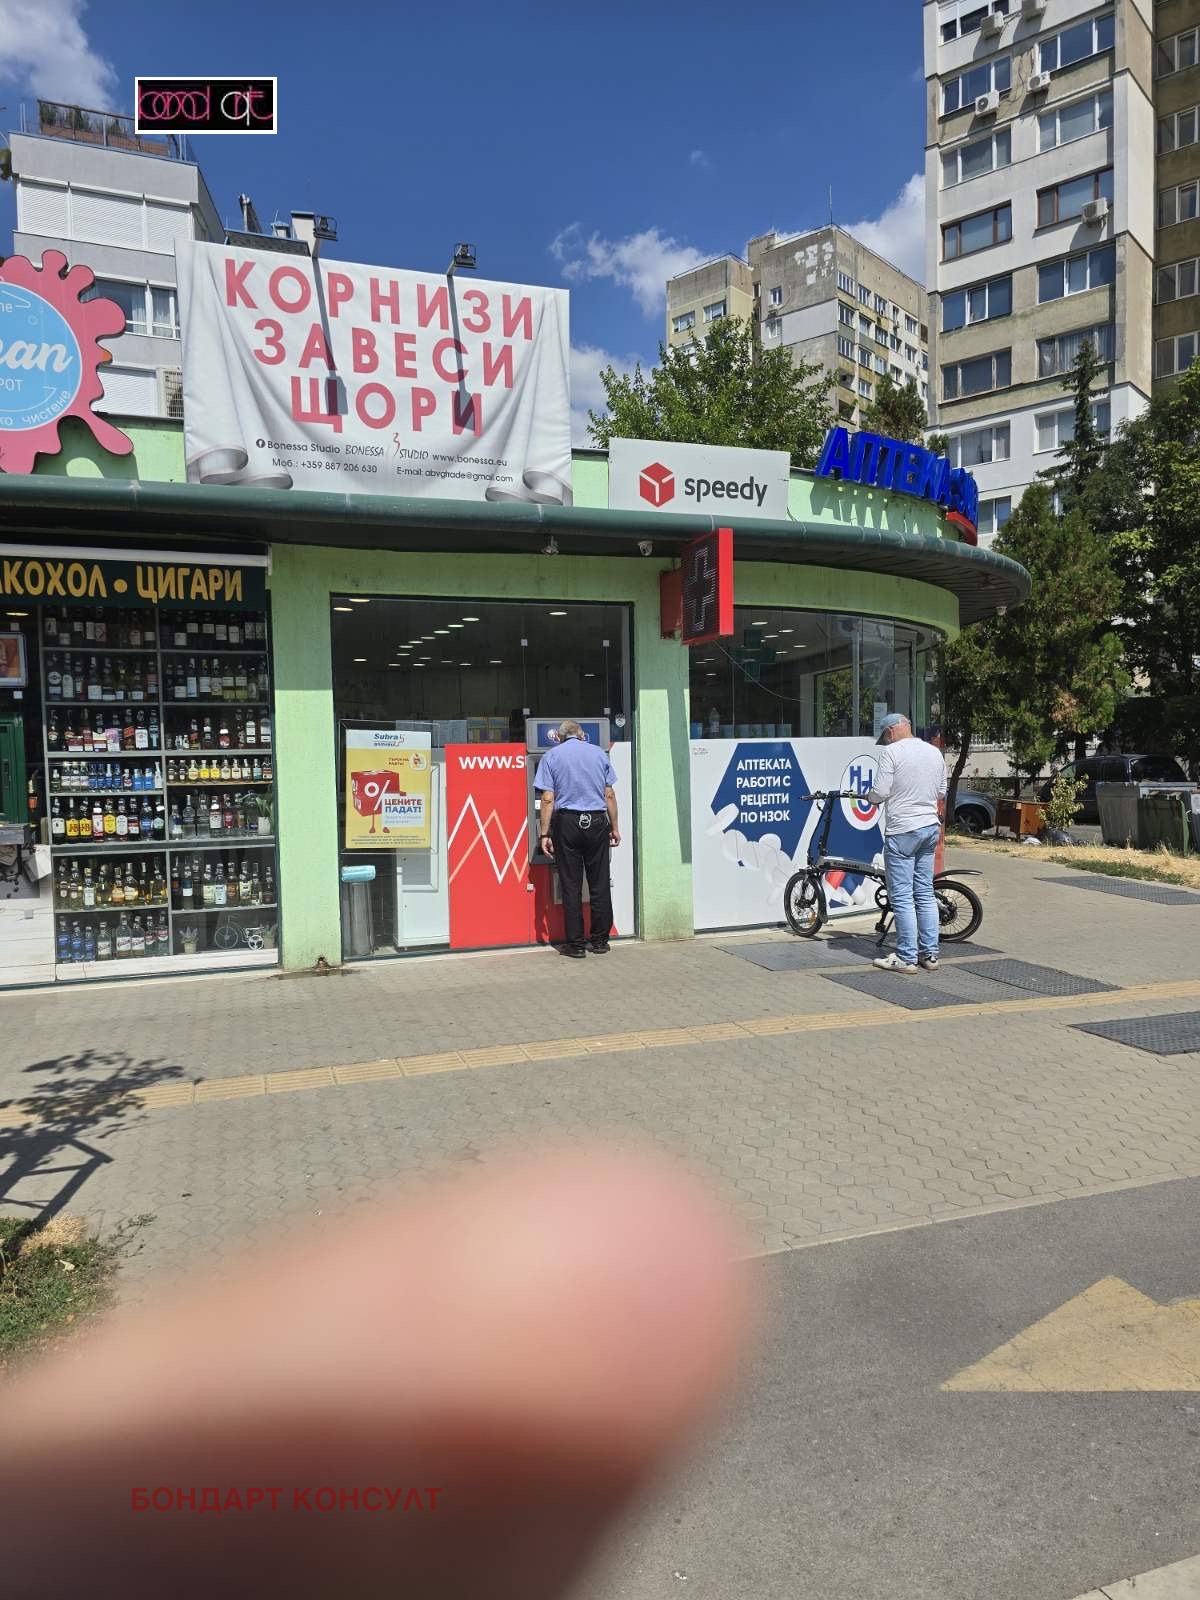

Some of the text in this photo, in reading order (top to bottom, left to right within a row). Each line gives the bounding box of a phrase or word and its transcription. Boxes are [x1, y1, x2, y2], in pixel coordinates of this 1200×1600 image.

[225, 259, 533, 340] КОРНИЗИ
[253, 318, 514, 389] ЗАВЕСИ
[290, 376, 484, 437] ЩОРИ
[267, 440, 508, 467] Bonessa Studio BONESSA STUDIO www.bonessa.eu
[301, 460, 323, 469] +359
[325, 462, 341, 470] 887
[343, 463, 359, 472] 206
[361, 464, 378, 473] 630
[816, 427, 950, 507] АПТЕКА
[684, 475, 768, 507] speedy
[0, 560, 243, 604] КОХОЛ ЦИГАРИ
[736, 758, 792, 771] АПТЕКАТА
[736, 775, 791, 788] РАБОТИ С
[384, 798, 422, 806] ЦЕНИТЕ
[385, 806, 422, 814] ПАДАТ!
[740, 793, 789, 807] РЕЦЕПТИ
[740, 810, 790, 824] ПО НЗОК
